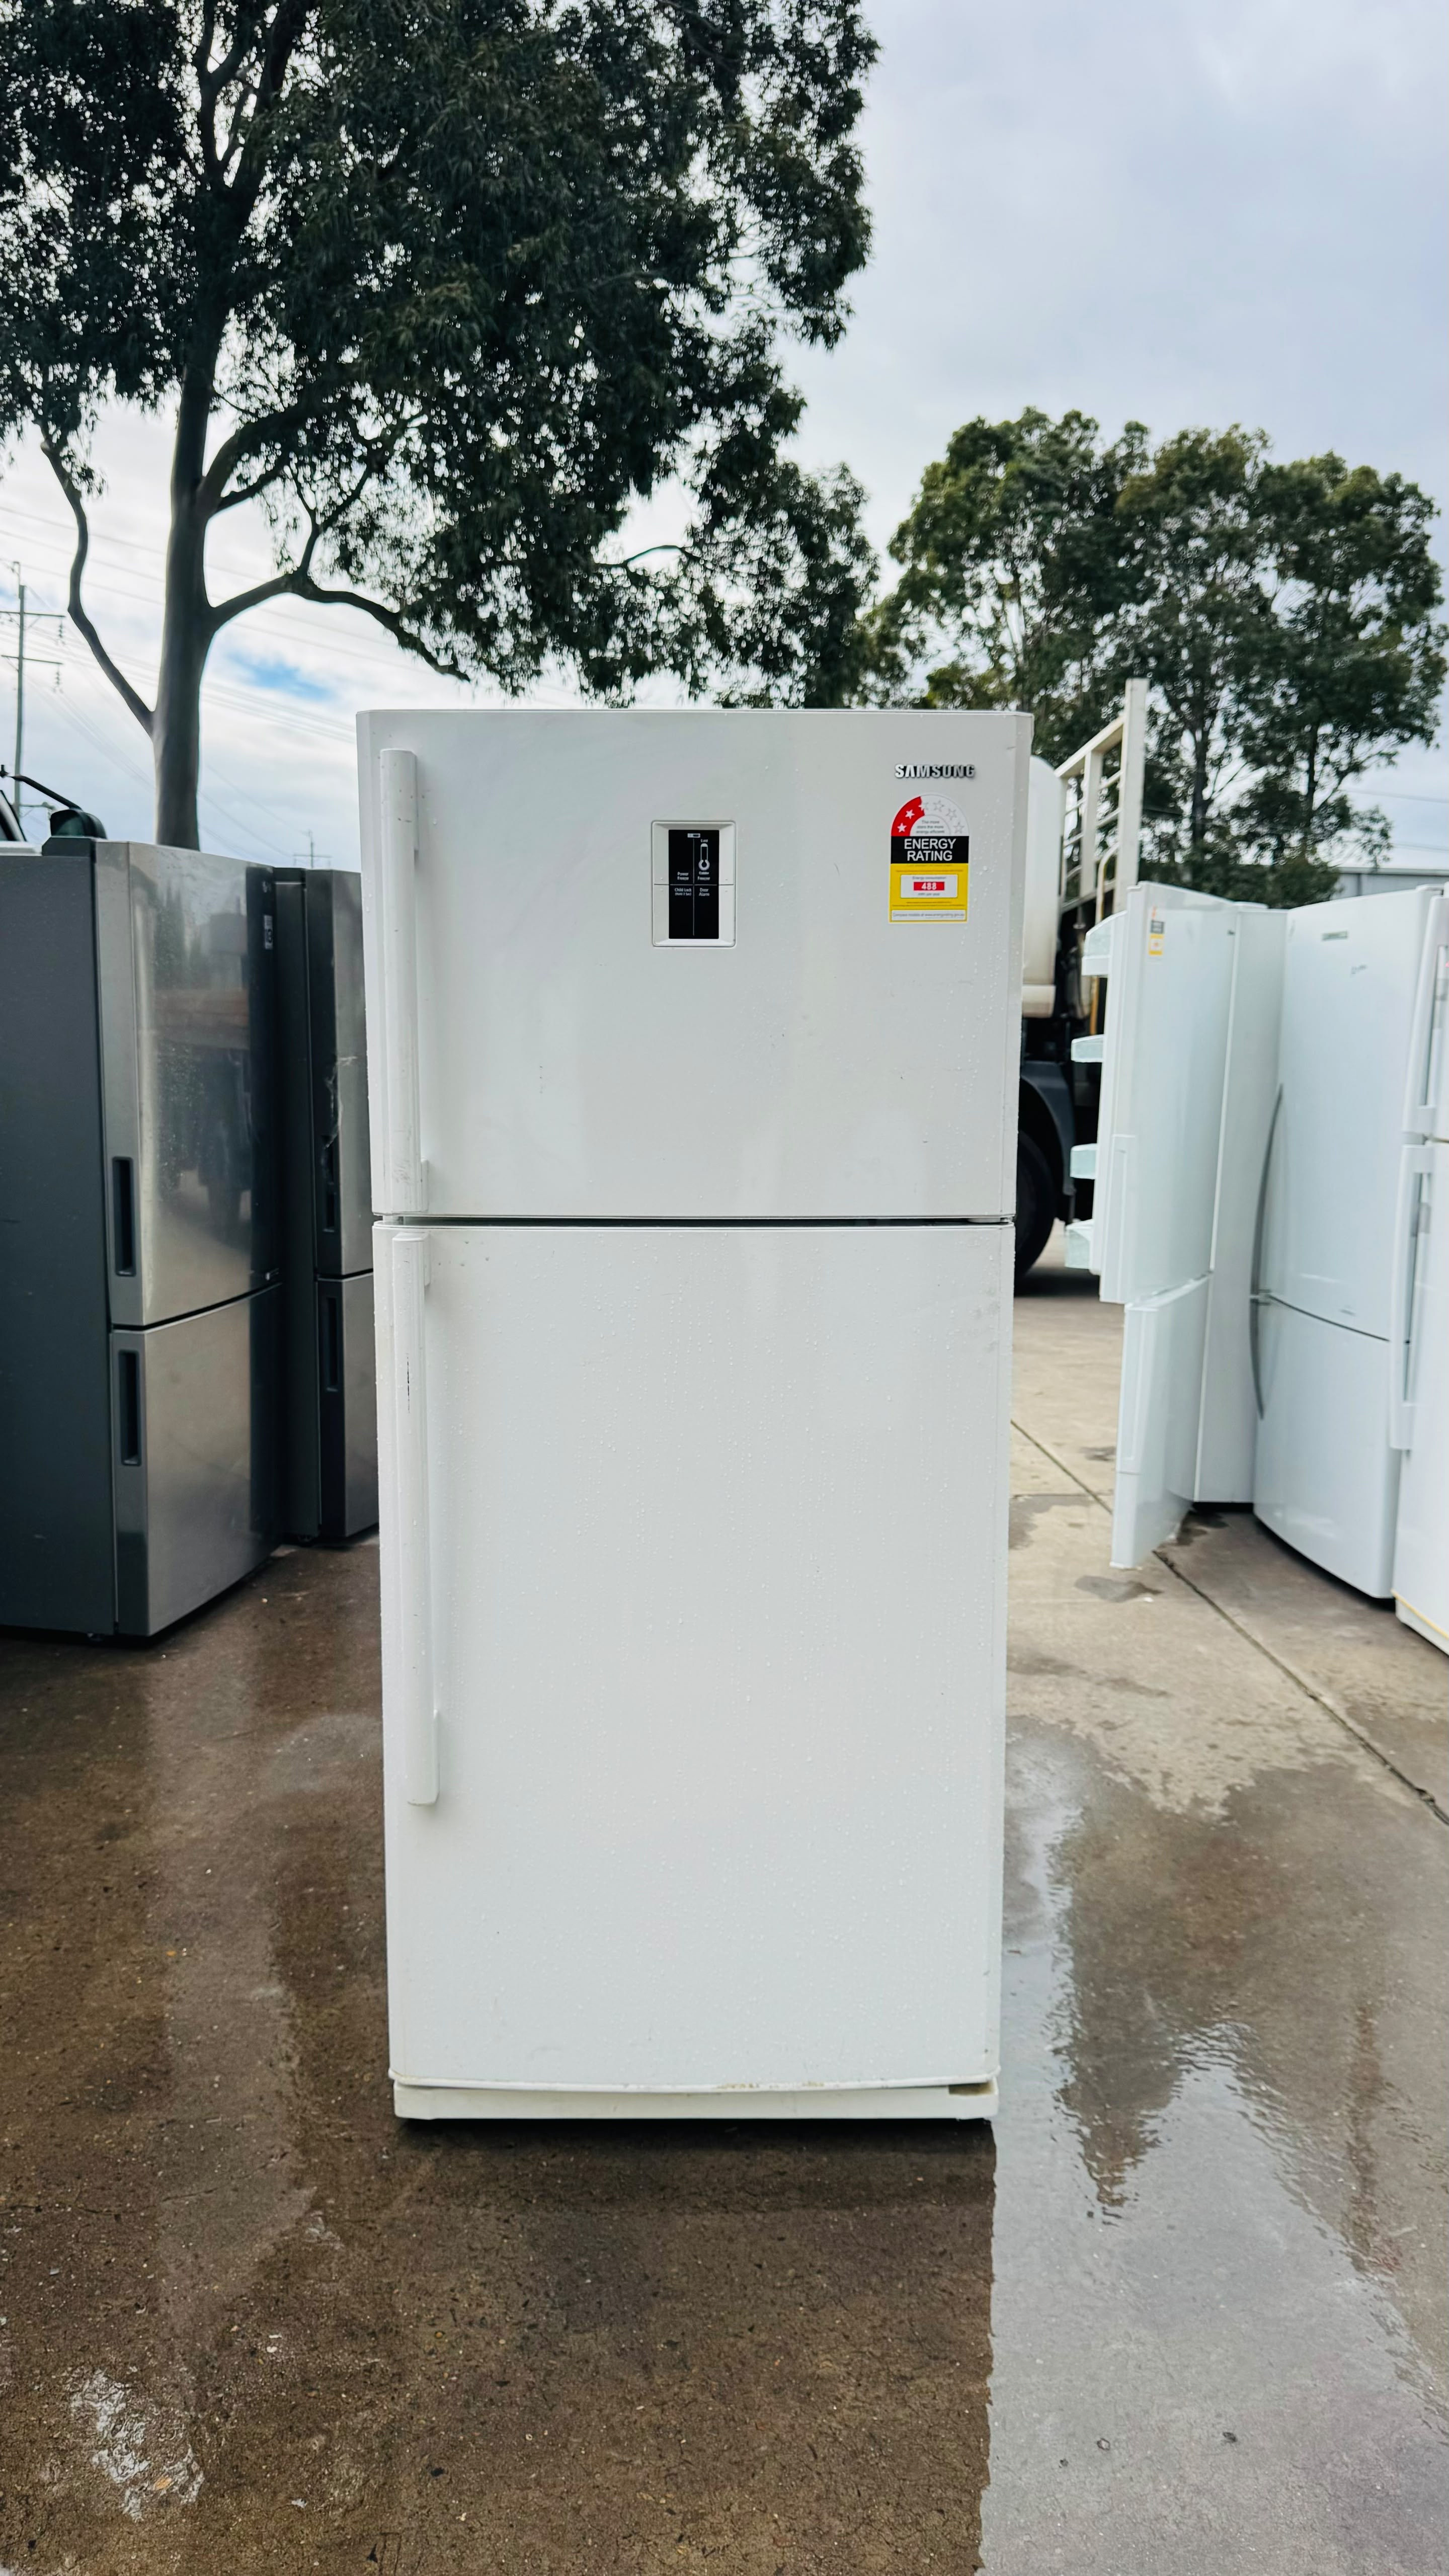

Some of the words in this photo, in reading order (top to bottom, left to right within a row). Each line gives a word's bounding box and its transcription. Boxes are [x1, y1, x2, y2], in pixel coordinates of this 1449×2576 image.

[895, 764, 975, 778] SAMSUNG
[904, 838, 956, 849] ENERGY
[907, 850, 952, 861] RATING
[921, 882, 937, 890] 488
